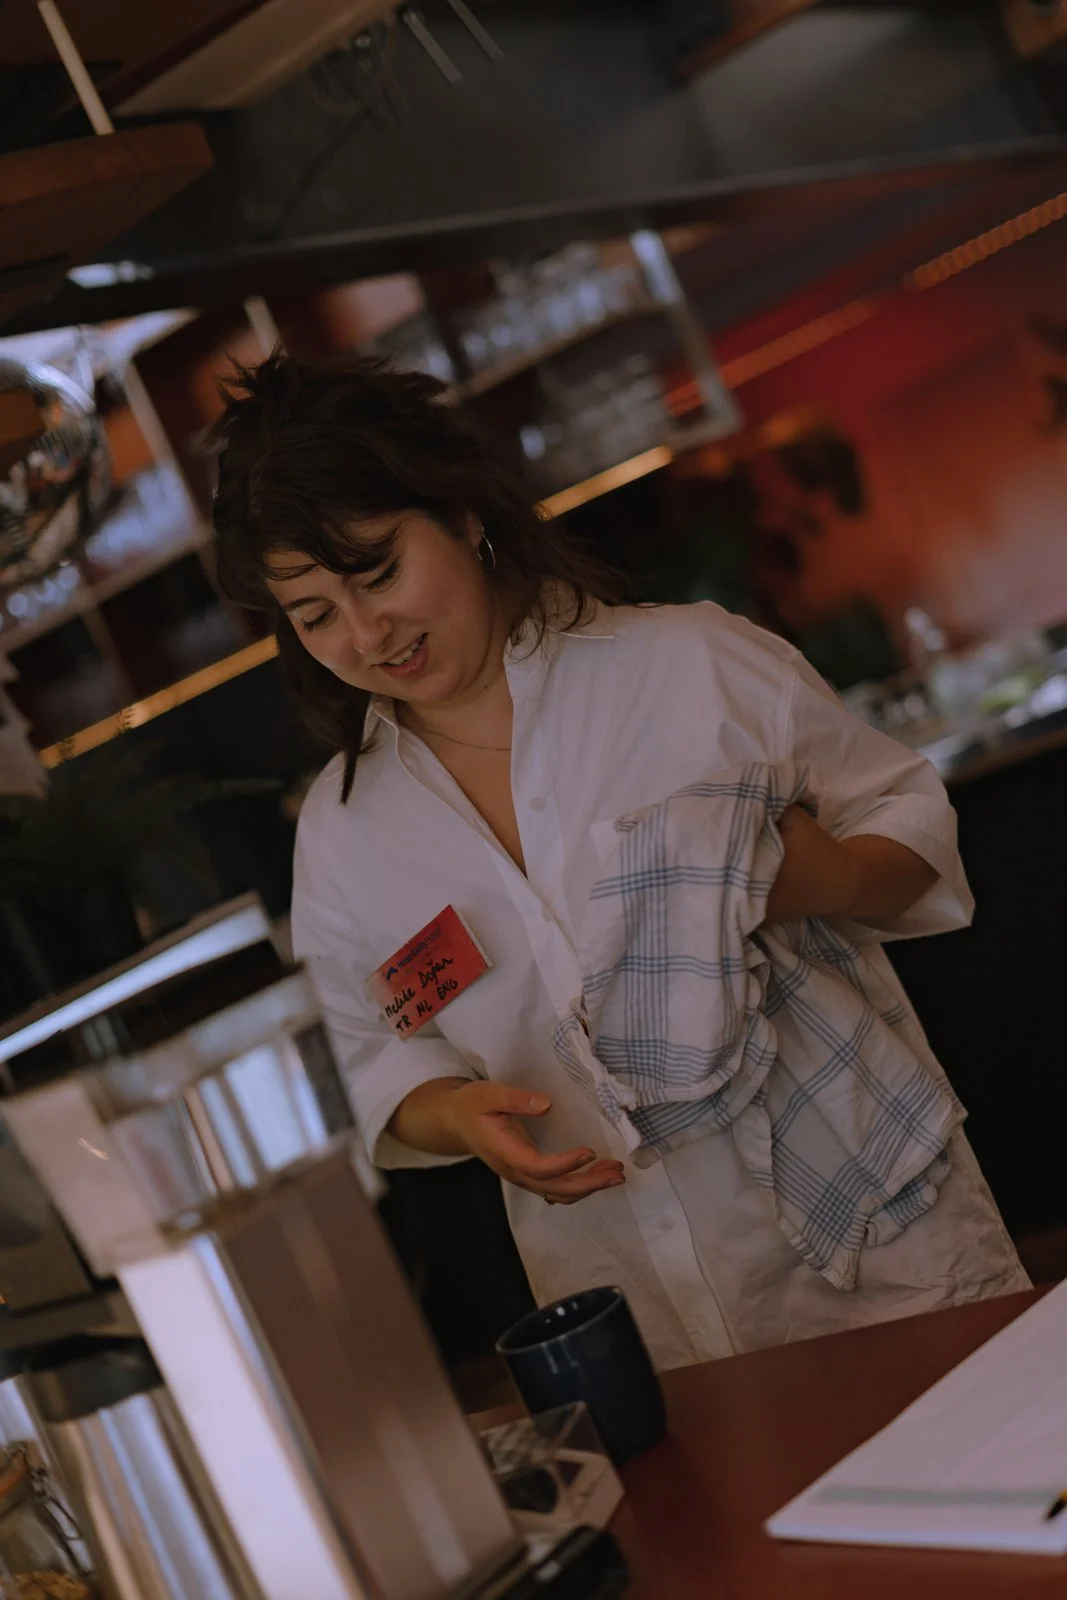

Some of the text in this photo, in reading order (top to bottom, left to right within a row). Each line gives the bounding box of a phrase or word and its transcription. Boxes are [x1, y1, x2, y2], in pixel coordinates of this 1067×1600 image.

[385, 988, 415, 1017] Melike
[396, 979, 458, 1032] TR NL ENG
